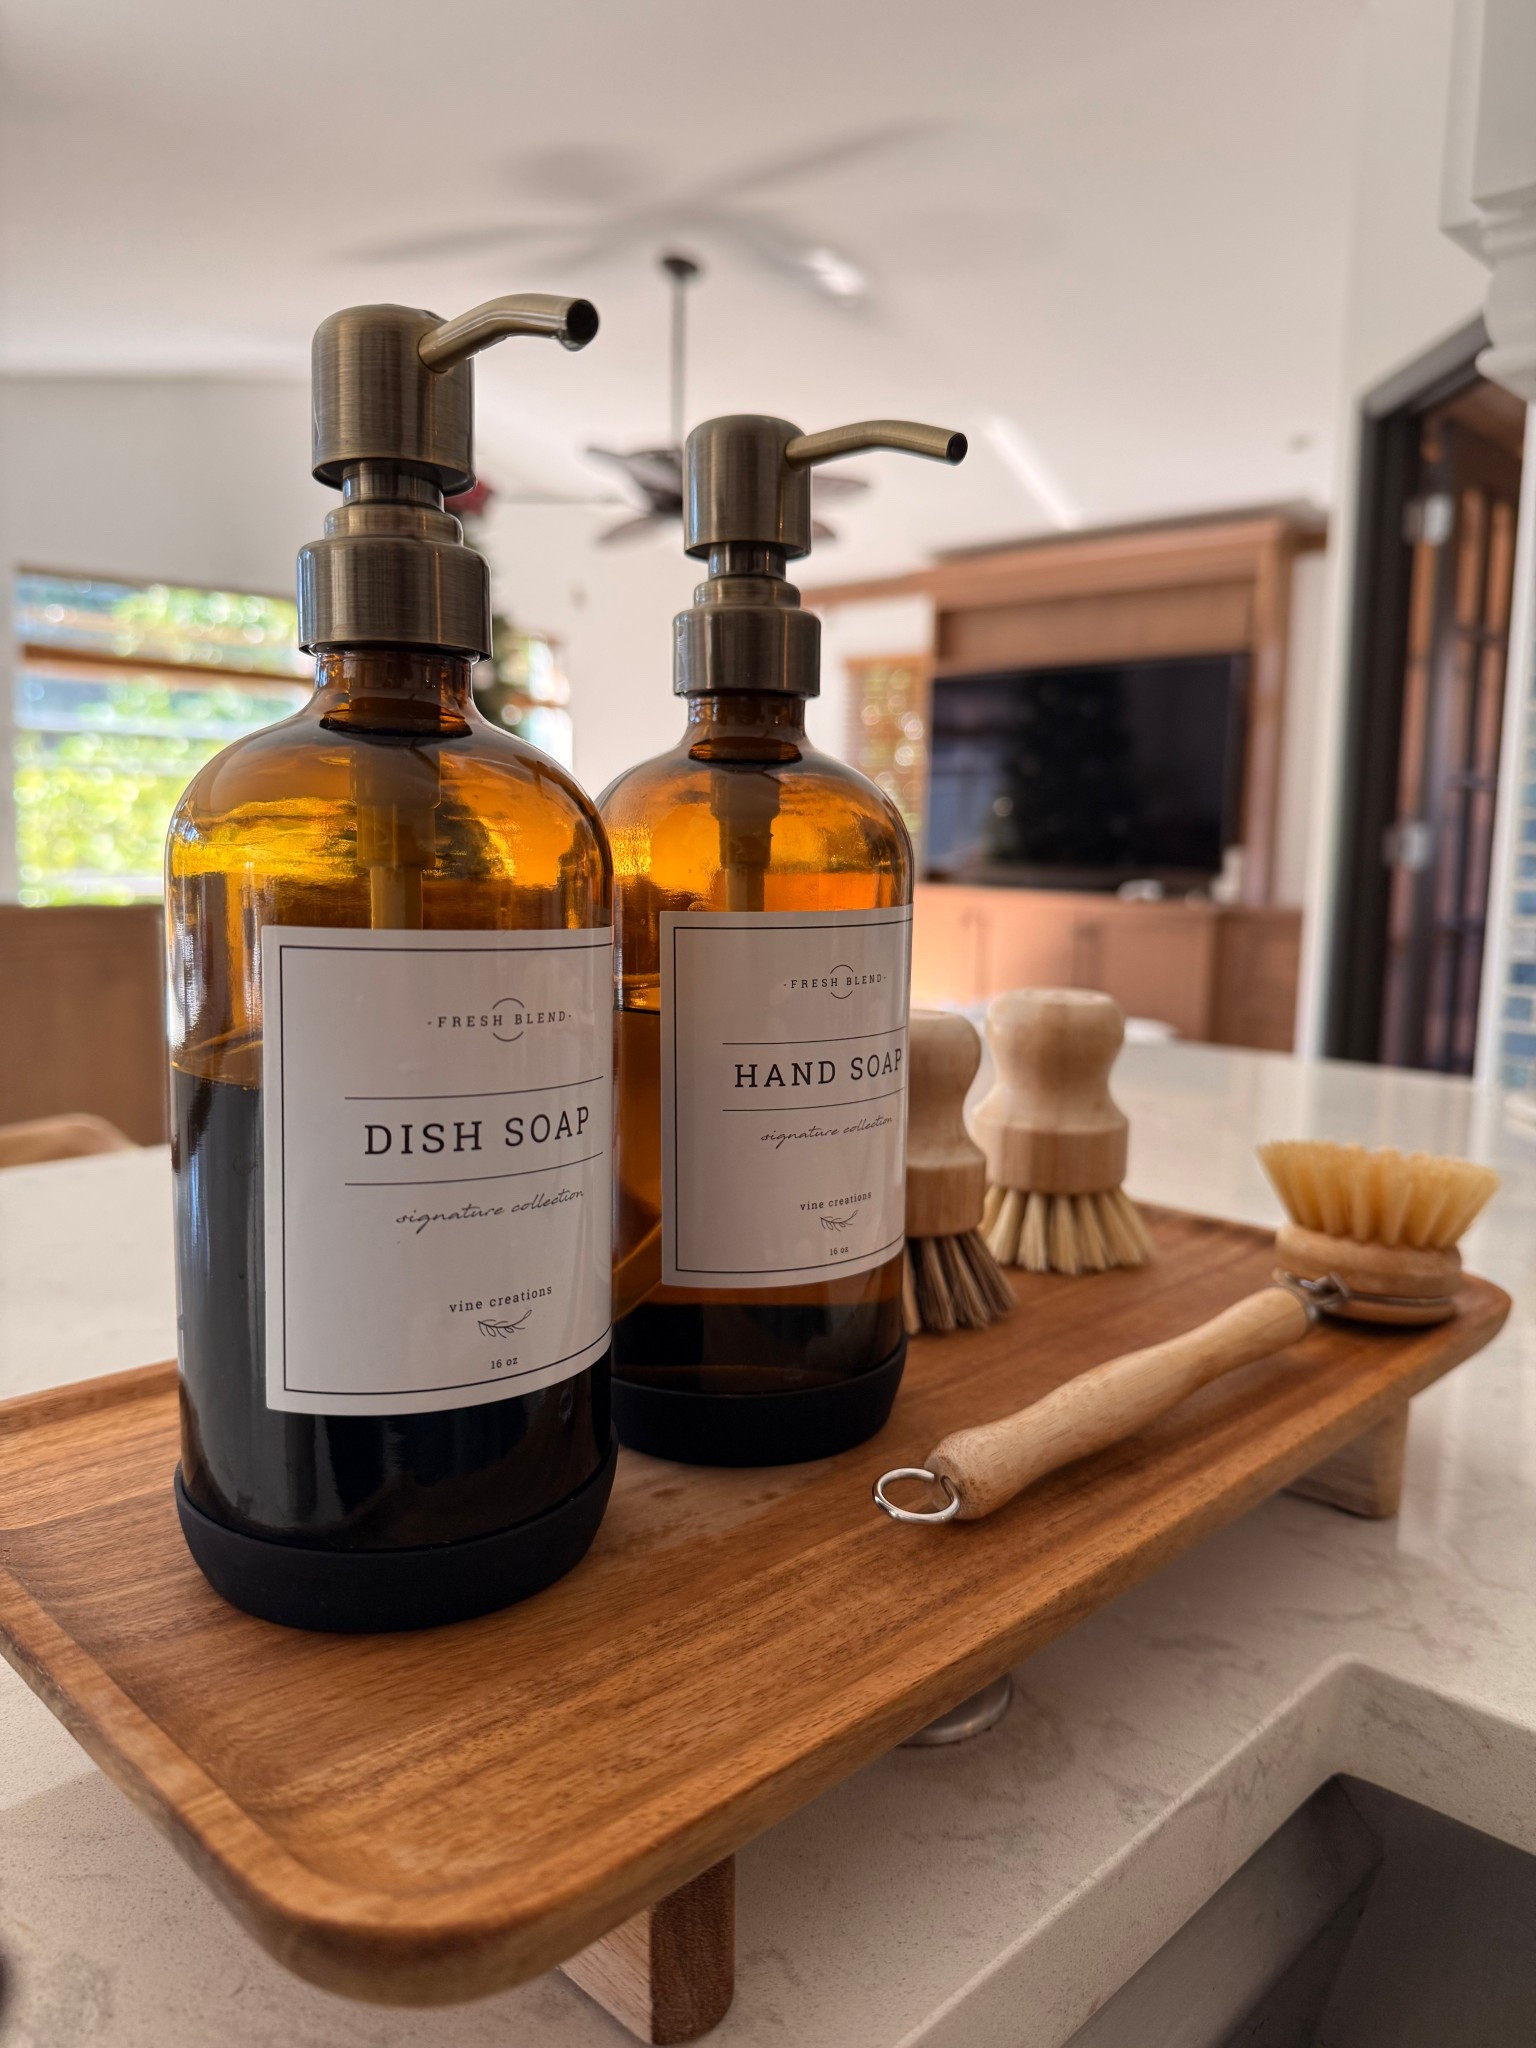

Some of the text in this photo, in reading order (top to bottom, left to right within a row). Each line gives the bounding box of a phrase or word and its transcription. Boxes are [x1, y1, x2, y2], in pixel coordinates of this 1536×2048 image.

[733, 1047, 902, 1088] HAND SOAP
[363, 1105, 590, 1156] DISH SOAP
[759, 1114, 894, 1150] signature collection
[394, 1187, 585, 1235] signature collection
[799, 1191, 872, 1212] vine creations
[829, 1246, 850, 1257] 16 oz
[448, 1284, 553, 1314] vine creations
[489, 1355, 520, 1371] 16 oz
